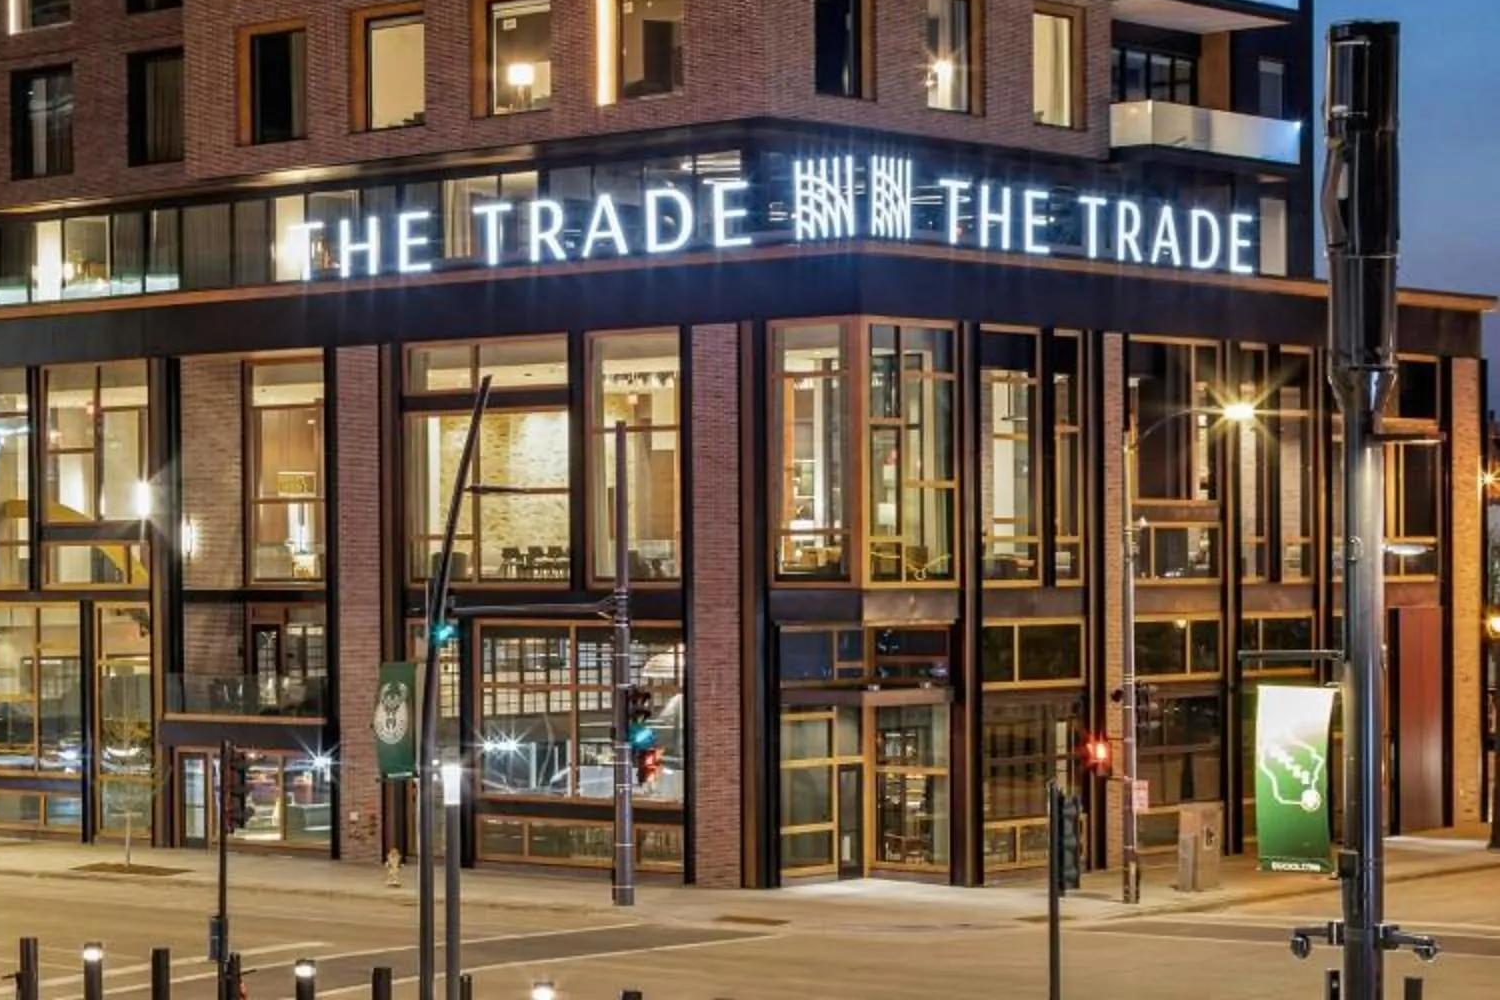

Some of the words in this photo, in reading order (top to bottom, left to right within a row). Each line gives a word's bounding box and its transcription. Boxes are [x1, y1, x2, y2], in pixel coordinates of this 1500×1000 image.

[289, 210, 431, 281] THE
[473, 179, 752, 265] TRADE
[939, 179, 1050, 253] THE
[1079, 195, 1254, 273] TRADE
